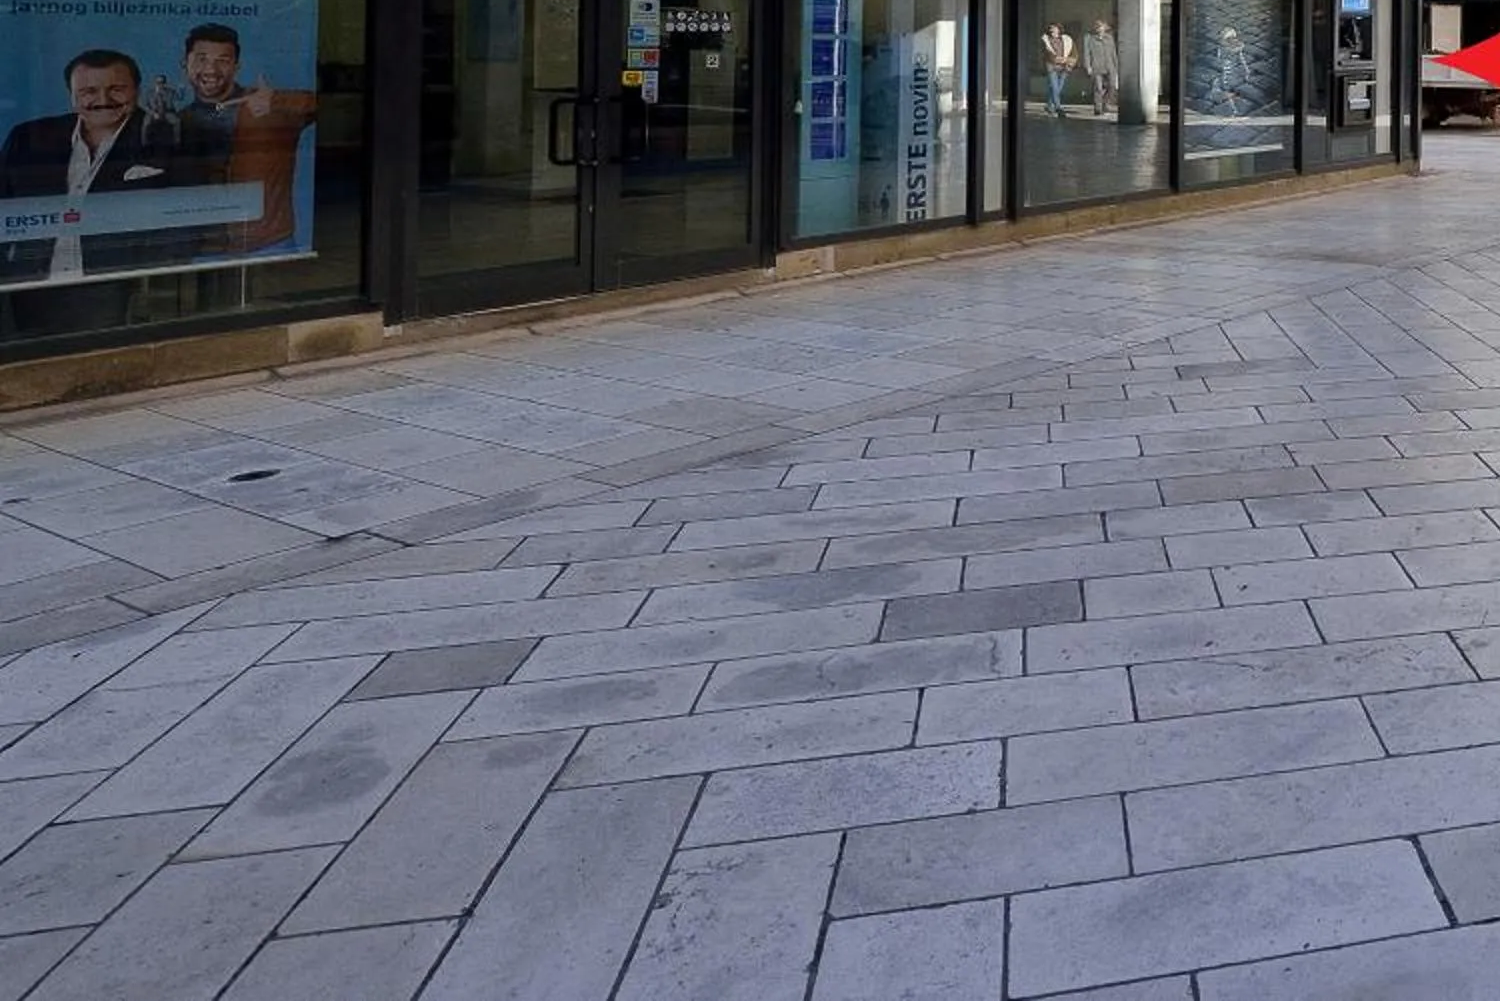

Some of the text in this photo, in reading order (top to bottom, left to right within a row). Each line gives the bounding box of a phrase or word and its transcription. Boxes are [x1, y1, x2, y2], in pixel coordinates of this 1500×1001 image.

[10, 0, 87, 15] javnog
[94, 1, 191, 16] bilježnika
[906, 143, 928, 223] ERSTE
[6, 212, 60, 228] ERSTE
